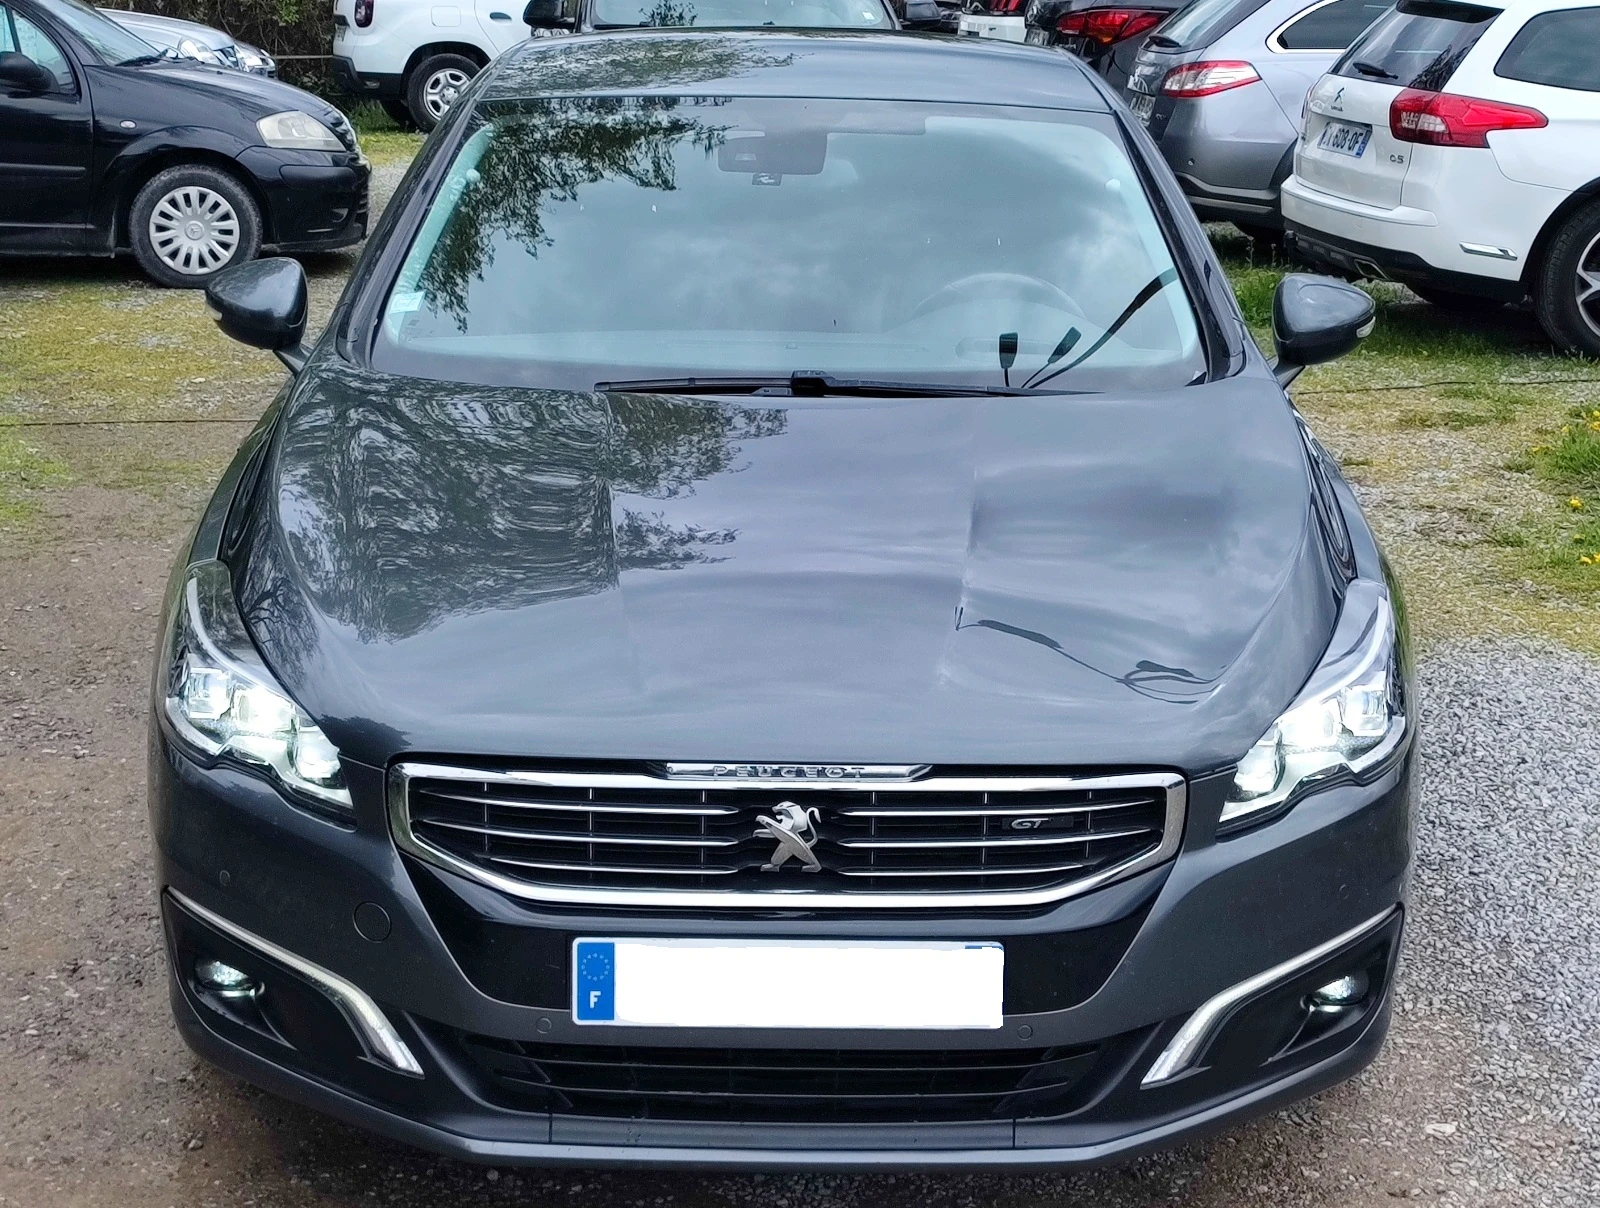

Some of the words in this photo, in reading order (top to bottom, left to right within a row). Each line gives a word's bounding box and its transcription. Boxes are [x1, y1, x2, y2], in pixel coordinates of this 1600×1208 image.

[712, 765, 865, 778] PEUGEOT
[1011, 817, 1049, 829] GT
[589, 990, 602, 1009] F
